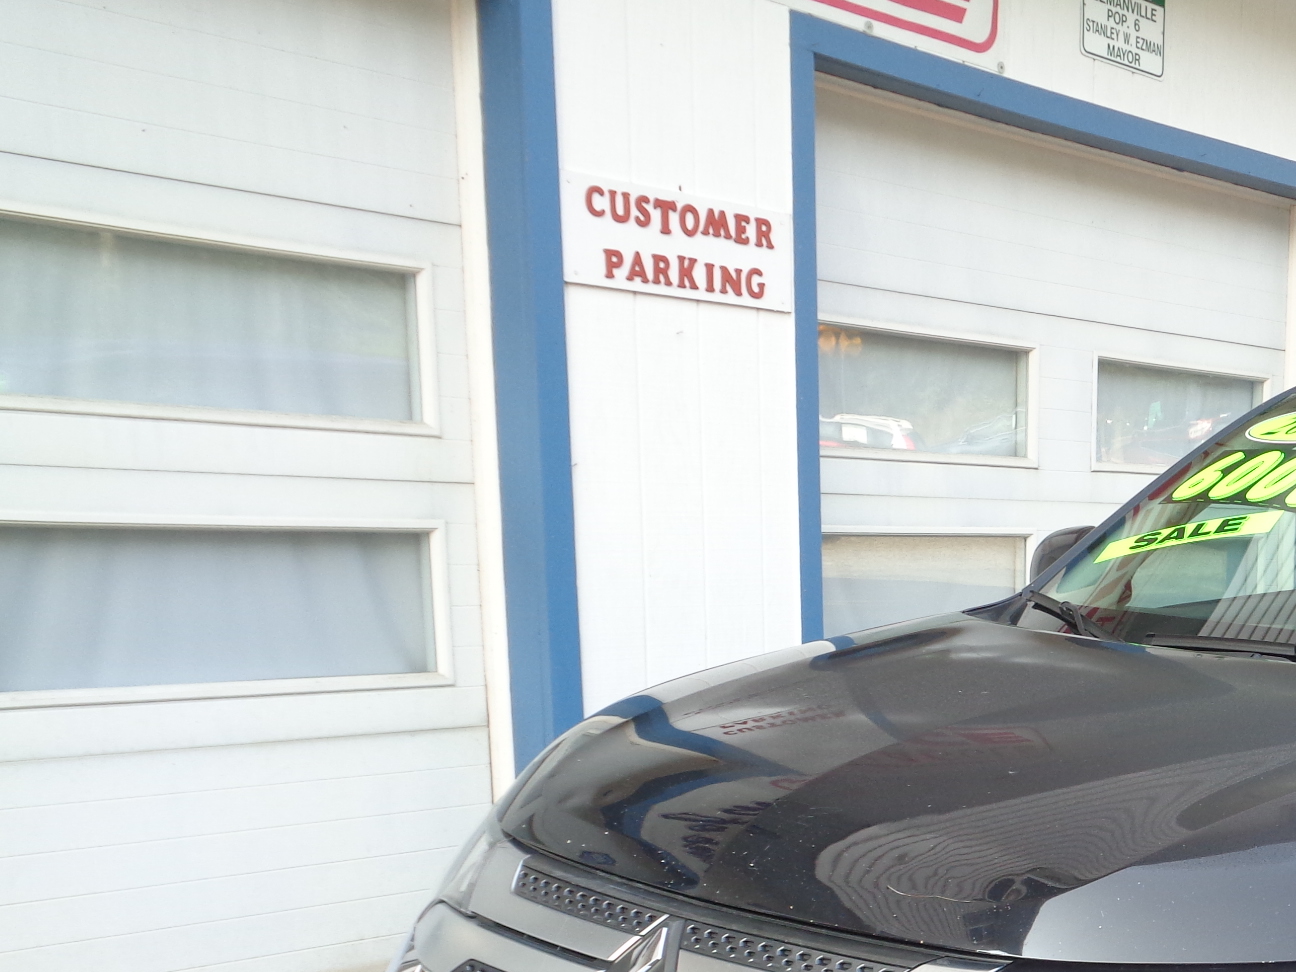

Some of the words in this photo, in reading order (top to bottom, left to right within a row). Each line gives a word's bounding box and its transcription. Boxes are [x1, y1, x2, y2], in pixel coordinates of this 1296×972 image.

[1085, 17, 1121, 42] STANLEY
[1123, 31, 1133, 47] W.
[1135, 35, 1162, 57] EZMAN
[1107, 8, 1130, 29] POP.
[1133, 18, 1141, 32] 6
[1107, 43, 1141, 67] MAYOR
[585, 185, 774, 249] CUSTOMER
[603, 248, 766, 299] PARKING
[1129, 515, 1248, 550] SALE
